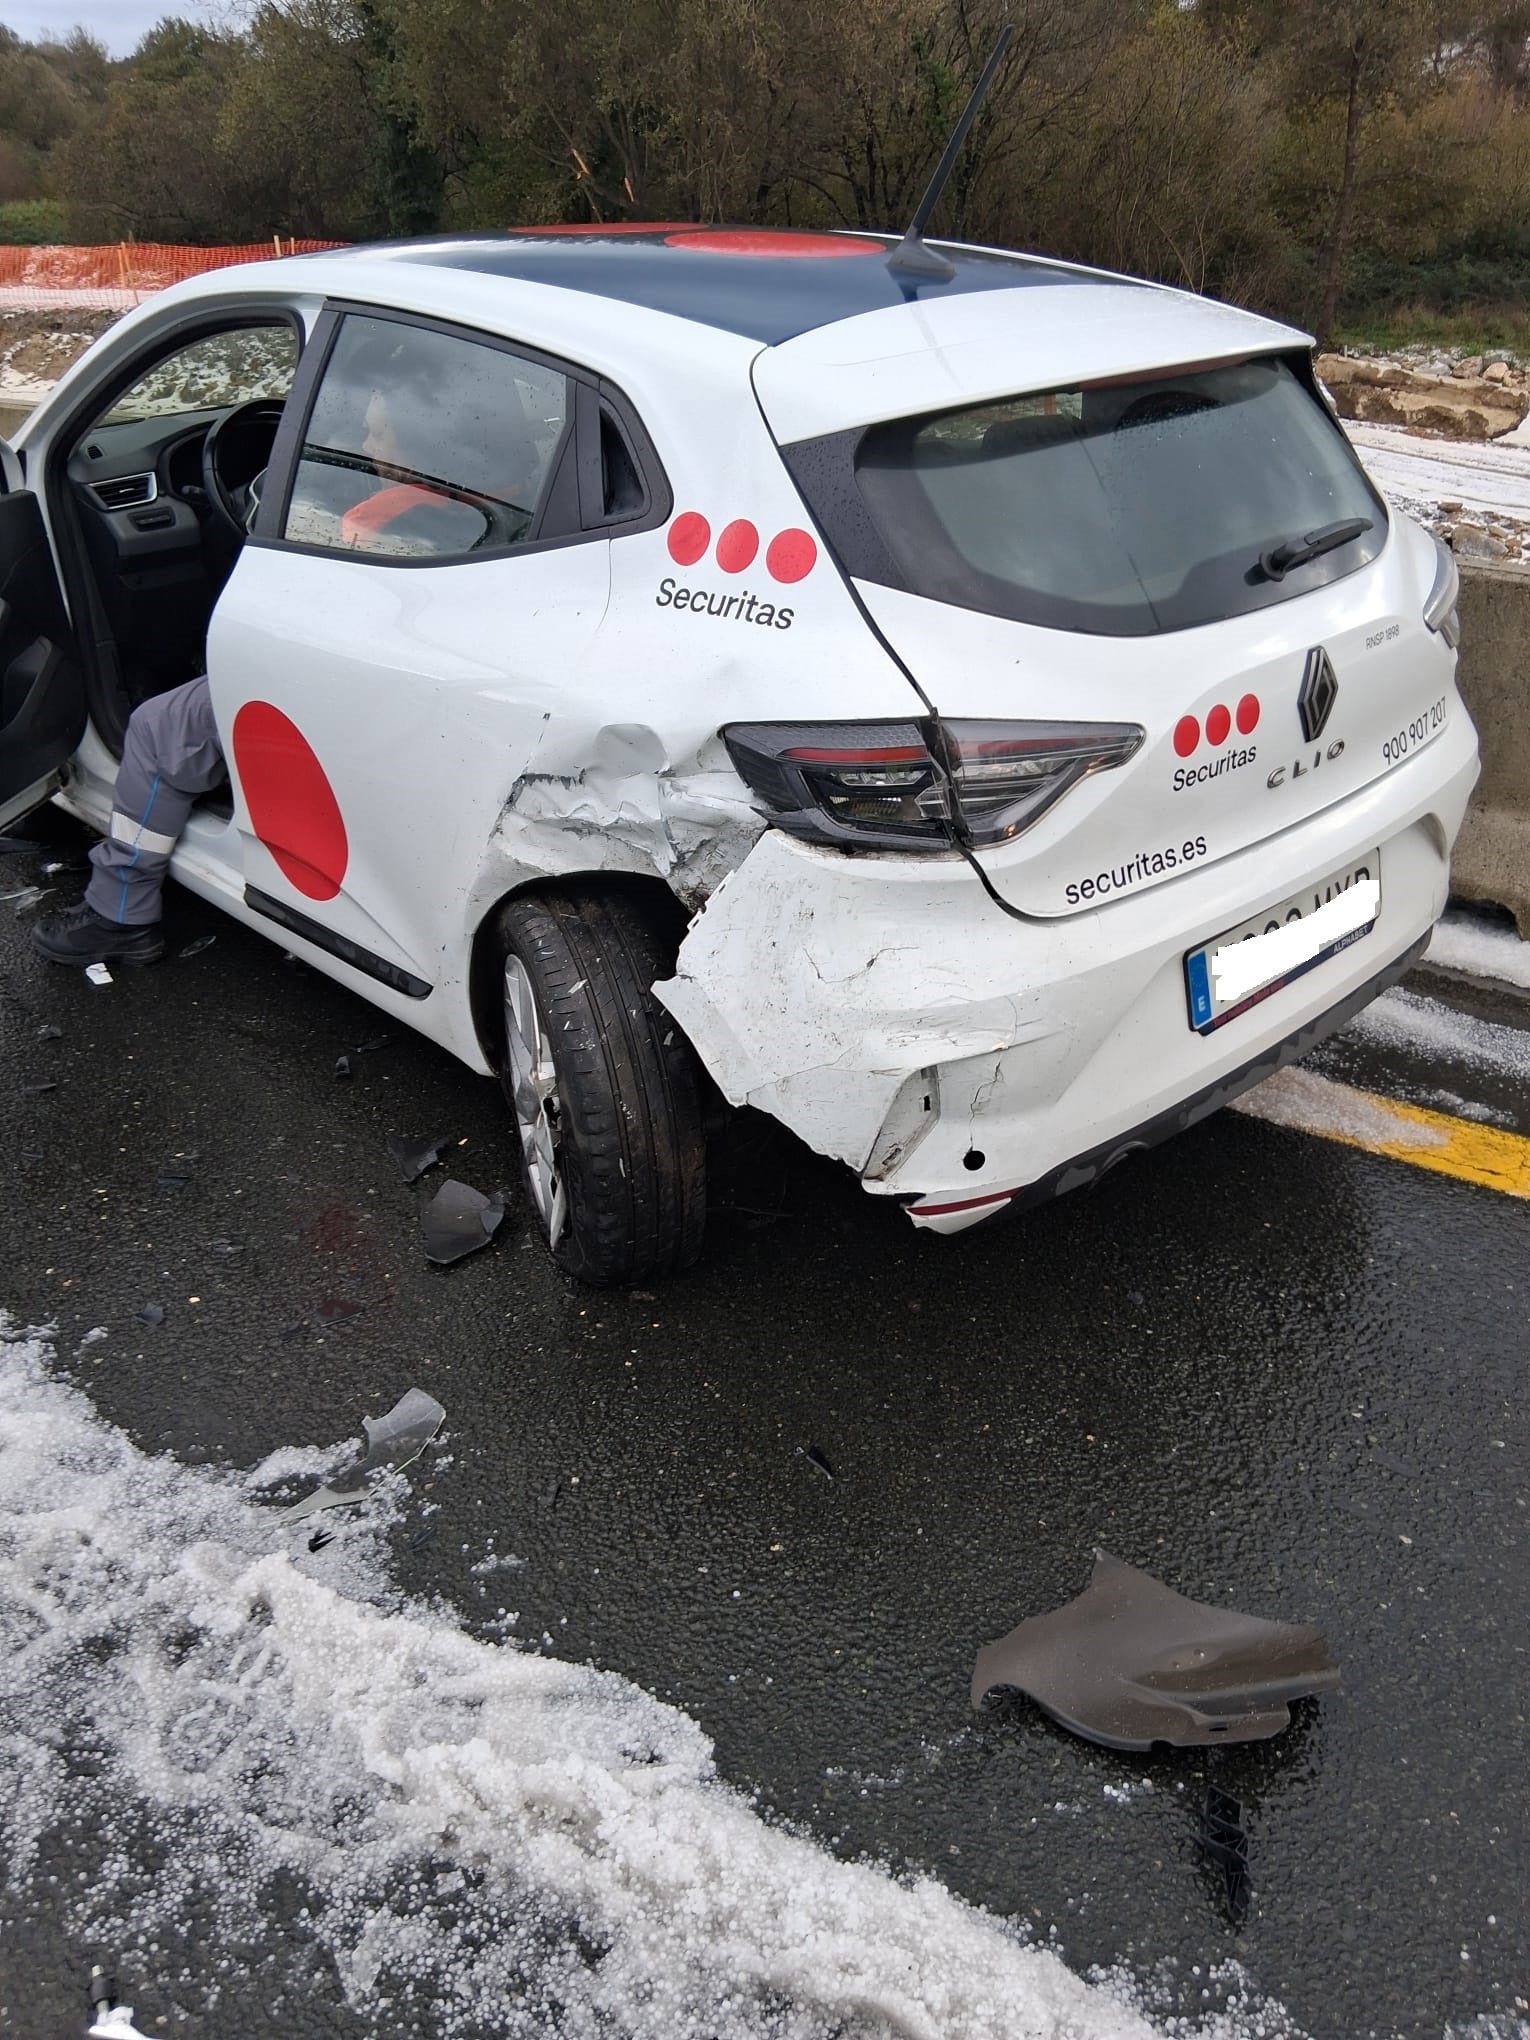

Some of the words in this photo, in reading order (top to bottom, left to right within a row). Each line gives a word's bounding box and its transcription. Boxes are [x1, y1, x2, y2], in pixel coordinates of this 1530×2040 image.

[656, 578, 795, 629] Securitas
[1366, 631, 1385, 650] RNSP
[1383, 731, 1407, 765] 900
[1409, 712, 1428, 745] 907
[1430, 696, 1446, 728] 207
[1173, 745, 1257, 791] Securitas
[1267, 738, 1345, 788] CLIO
[1065, 835, 1208, 904] securitas.es
[1333, 924, 1369, 953] ALPHABET
[1197, 996, 1206, 1011] E
